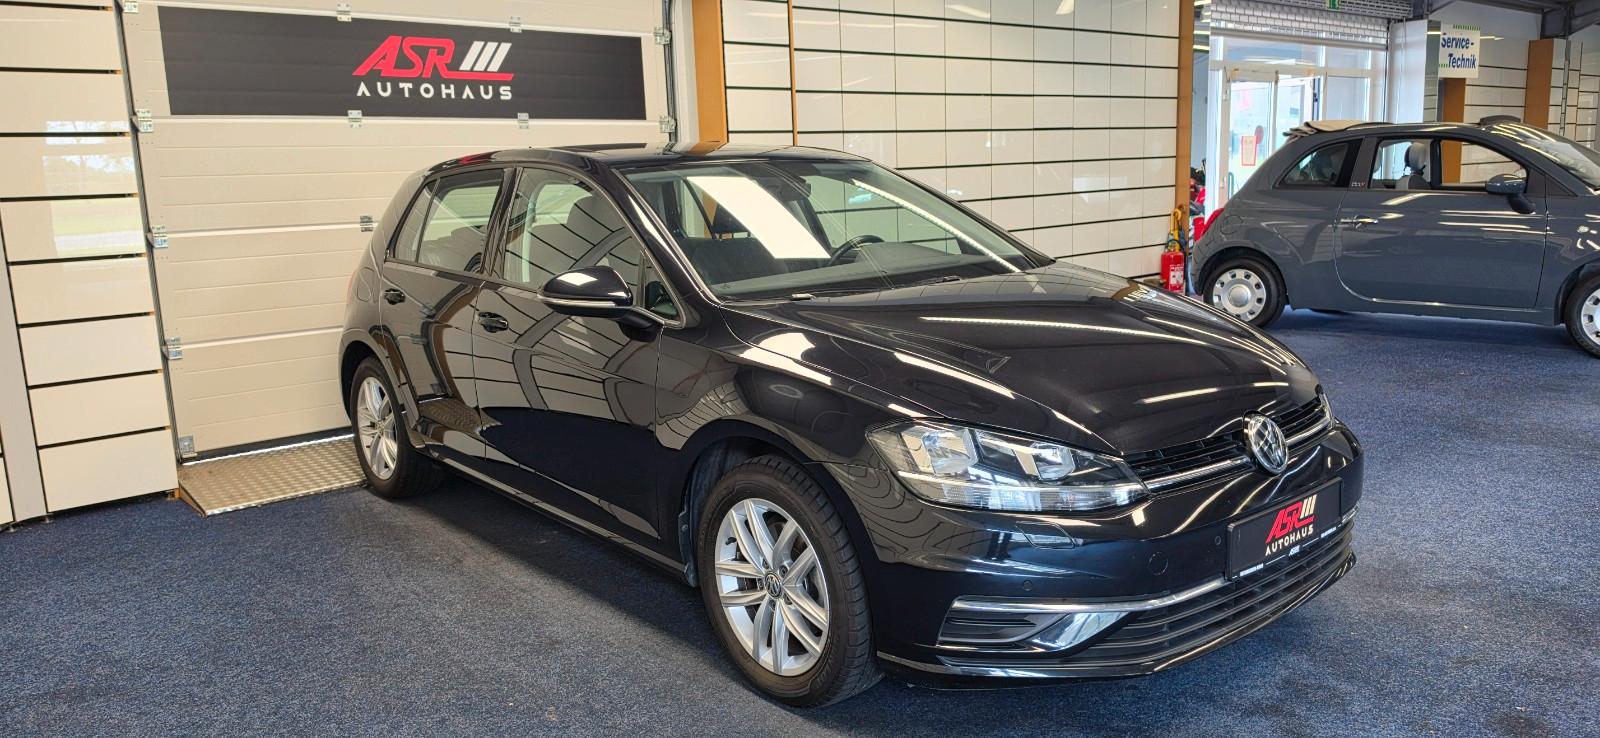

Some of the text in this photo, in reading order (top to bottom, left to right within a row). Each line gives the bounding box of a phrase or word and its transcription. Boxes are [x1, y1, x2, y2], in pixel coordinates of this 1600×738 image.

[1441, 36, 1474, 50] Service-
[1448, 52, 1476, 69] Technik
[356, 81, 513, 100] AUTOHAUS
[1265, 524, 1314, 556] AUTOHAUS
